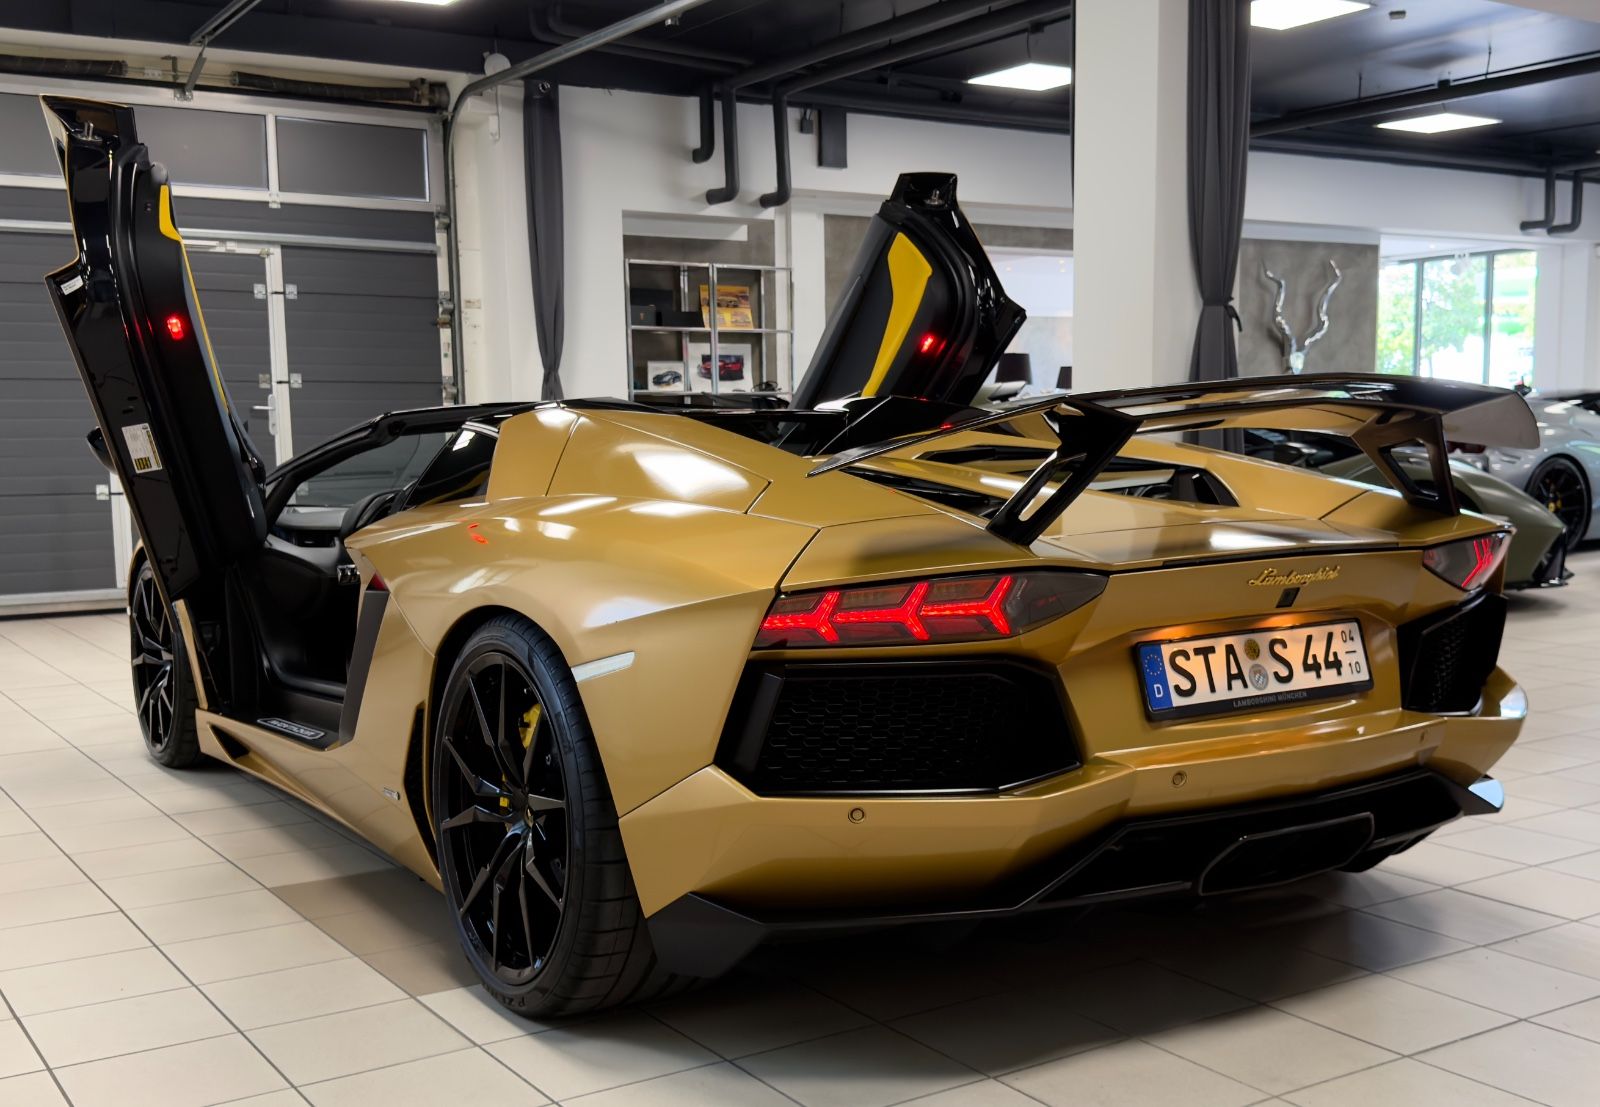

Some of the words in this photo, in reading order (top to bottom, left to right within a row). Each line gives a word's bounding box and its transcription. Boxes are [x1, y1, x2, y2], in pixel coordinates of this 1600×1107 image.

[1248, 566, 1341, 586] Lamborghini
[1340, 630, 1355, 643] 04
[1169, 643, 1248, 698] STA
[1269, 638, 1294, 684] S
[1302, 631, 1342, 679] 44
[1348, 661, 1361, 675] 10
[1153, 684, 1164, 698] D
[1233, 694, 1276, 708] LAMBORGHINI
[1277, 691, 1307, 701] MÜNCHEN
